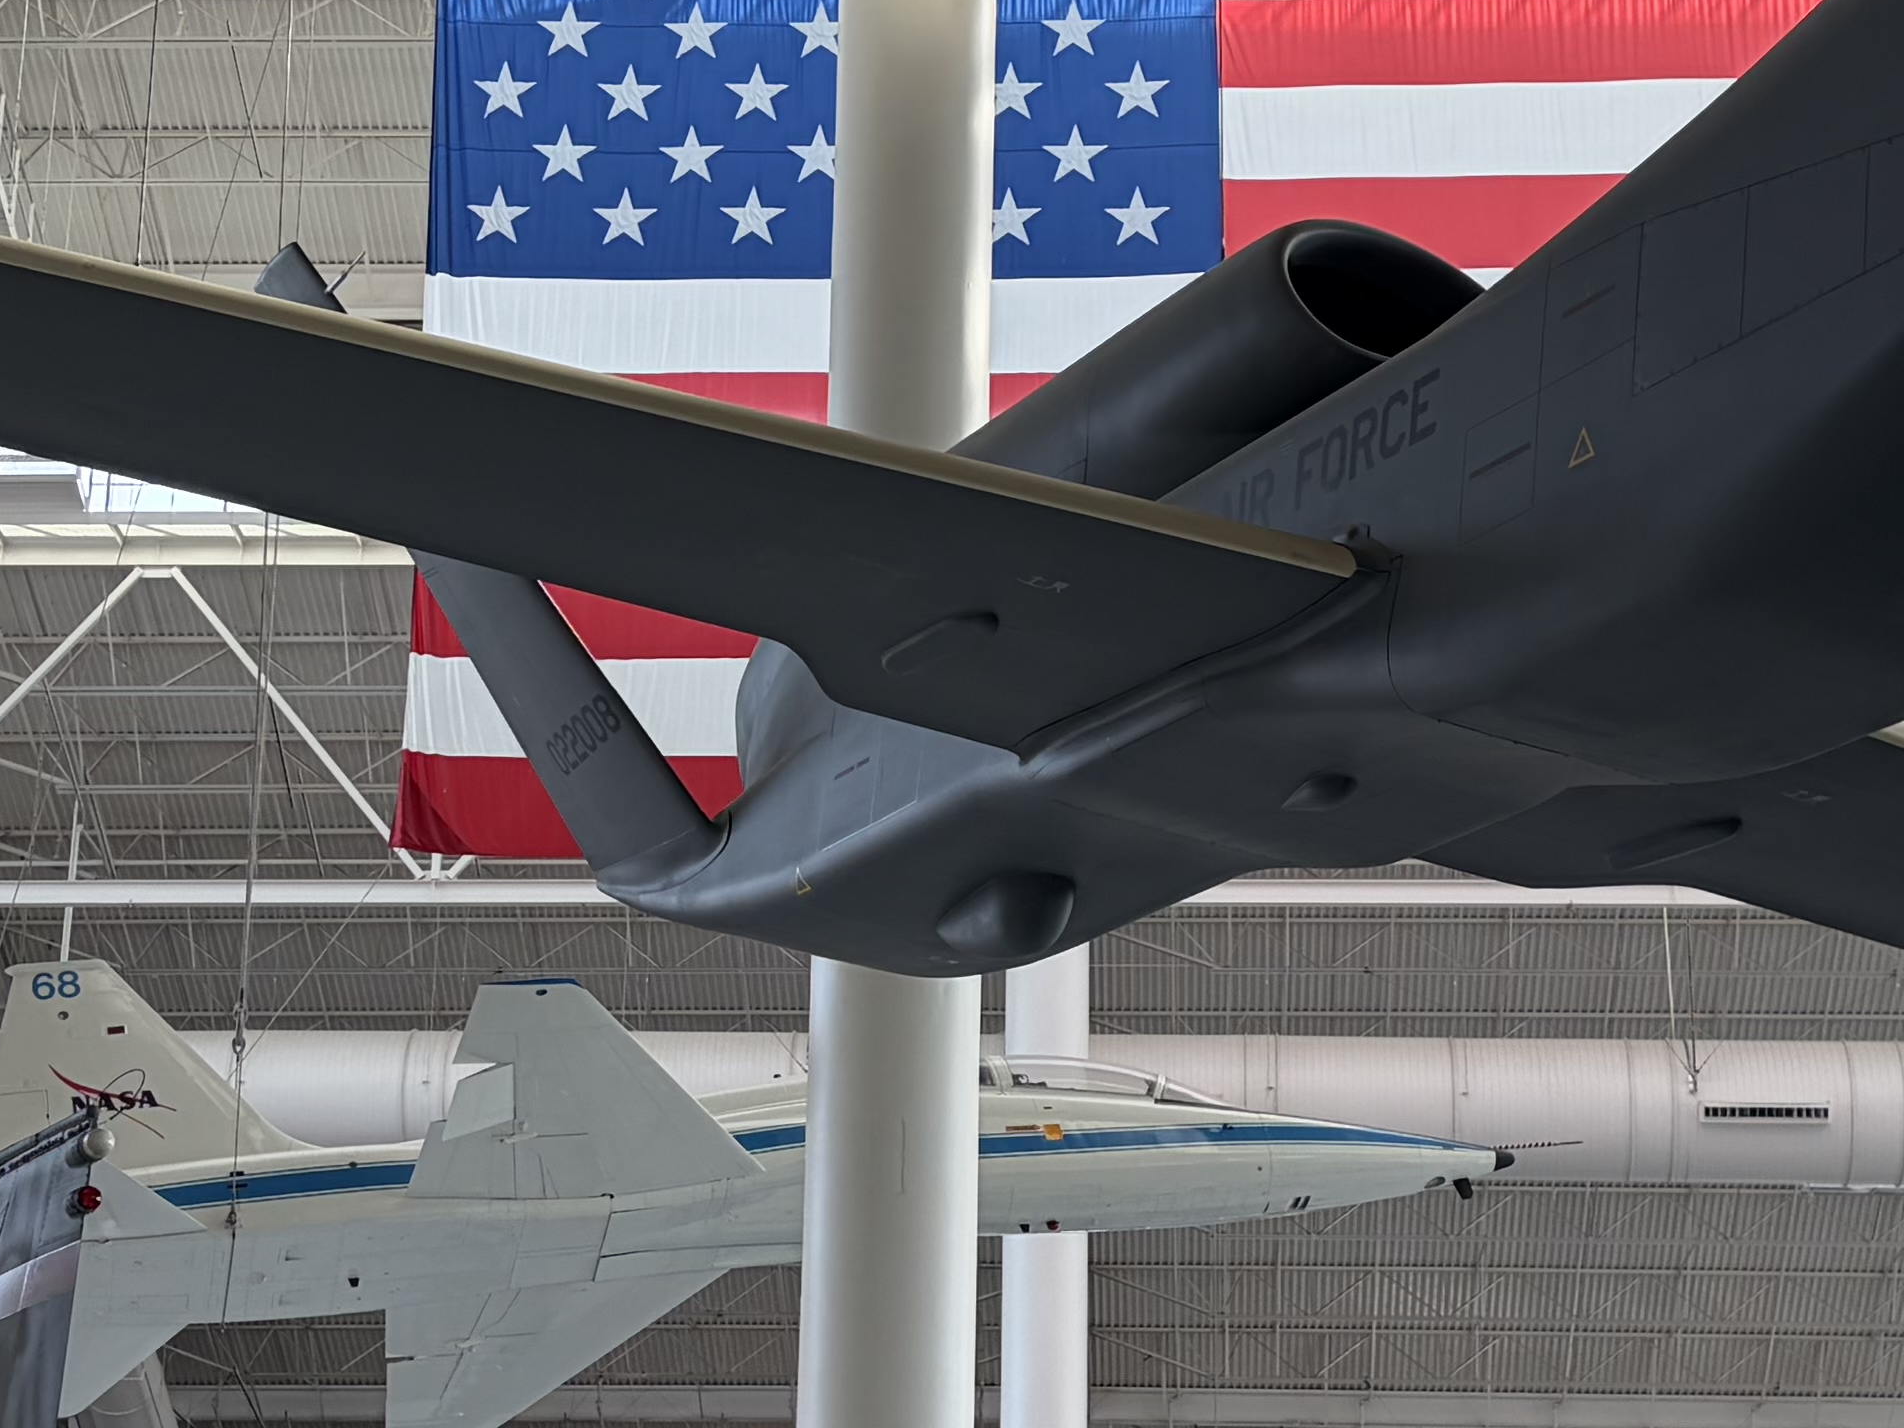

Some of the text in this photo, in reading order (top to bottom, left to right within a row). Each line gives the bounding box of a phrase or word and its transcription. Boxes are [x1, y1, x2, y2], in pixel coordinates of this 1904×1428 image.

[1295, 368, 1441, 512] FORCE
[546, 694, 621, 776] 022008
[31, 970, 81, 1001] 68
[71, 1089, 160, 1114] NASA
